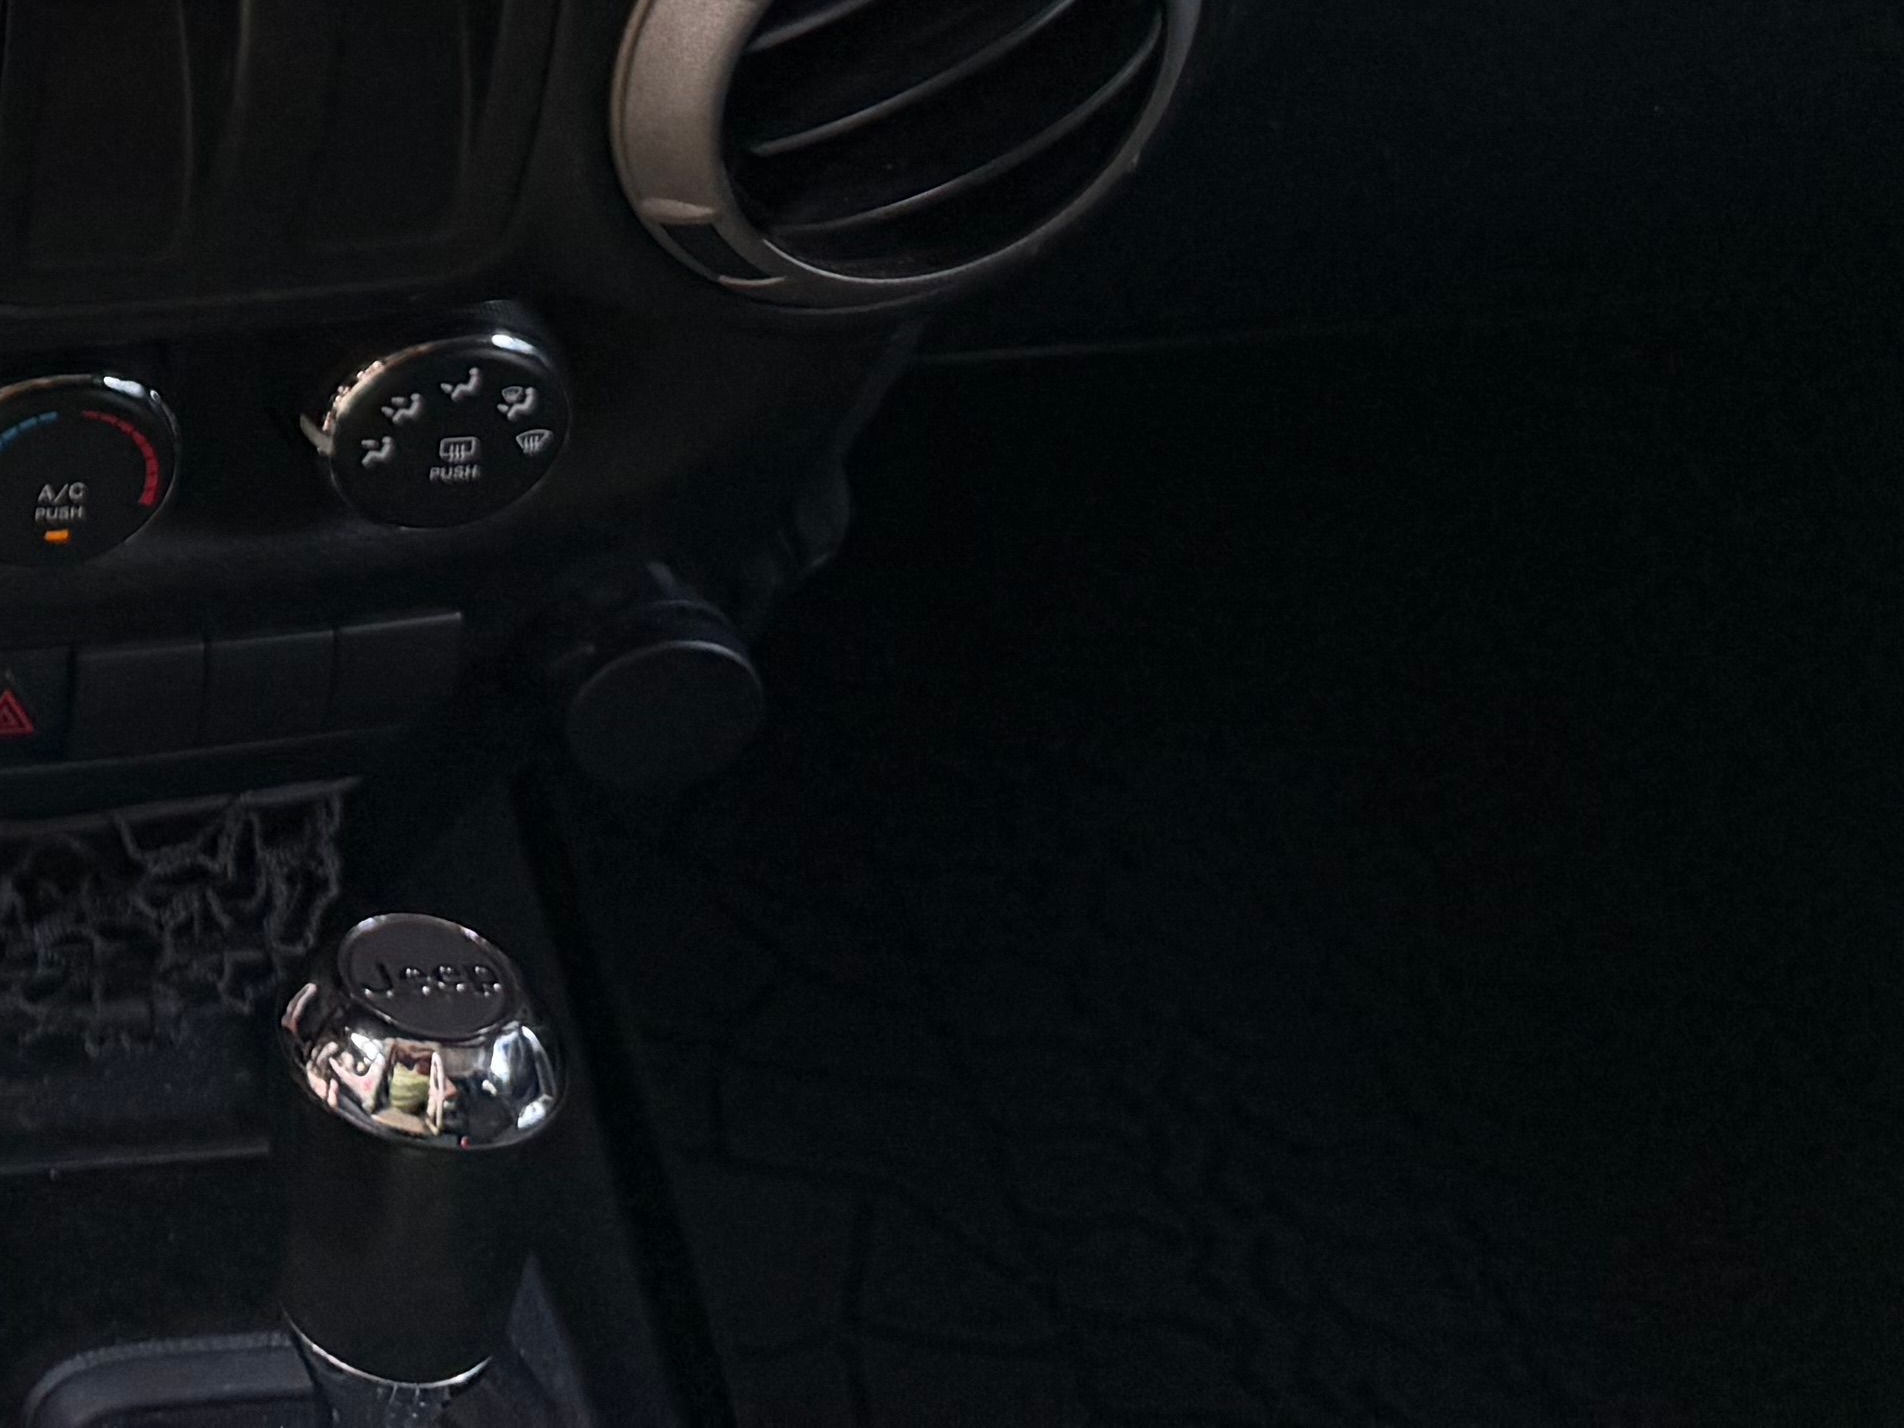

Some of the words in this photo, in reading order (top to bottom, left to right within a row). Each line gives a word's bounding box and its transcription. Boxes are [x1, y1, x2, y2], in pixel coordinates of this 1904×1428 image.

[429, 466, 478, 482] PUSH
[37, 481, 88, 505] A/C
[34, 505, 85, 522] PUSH
[363, 961, 503, 999] Jeep
